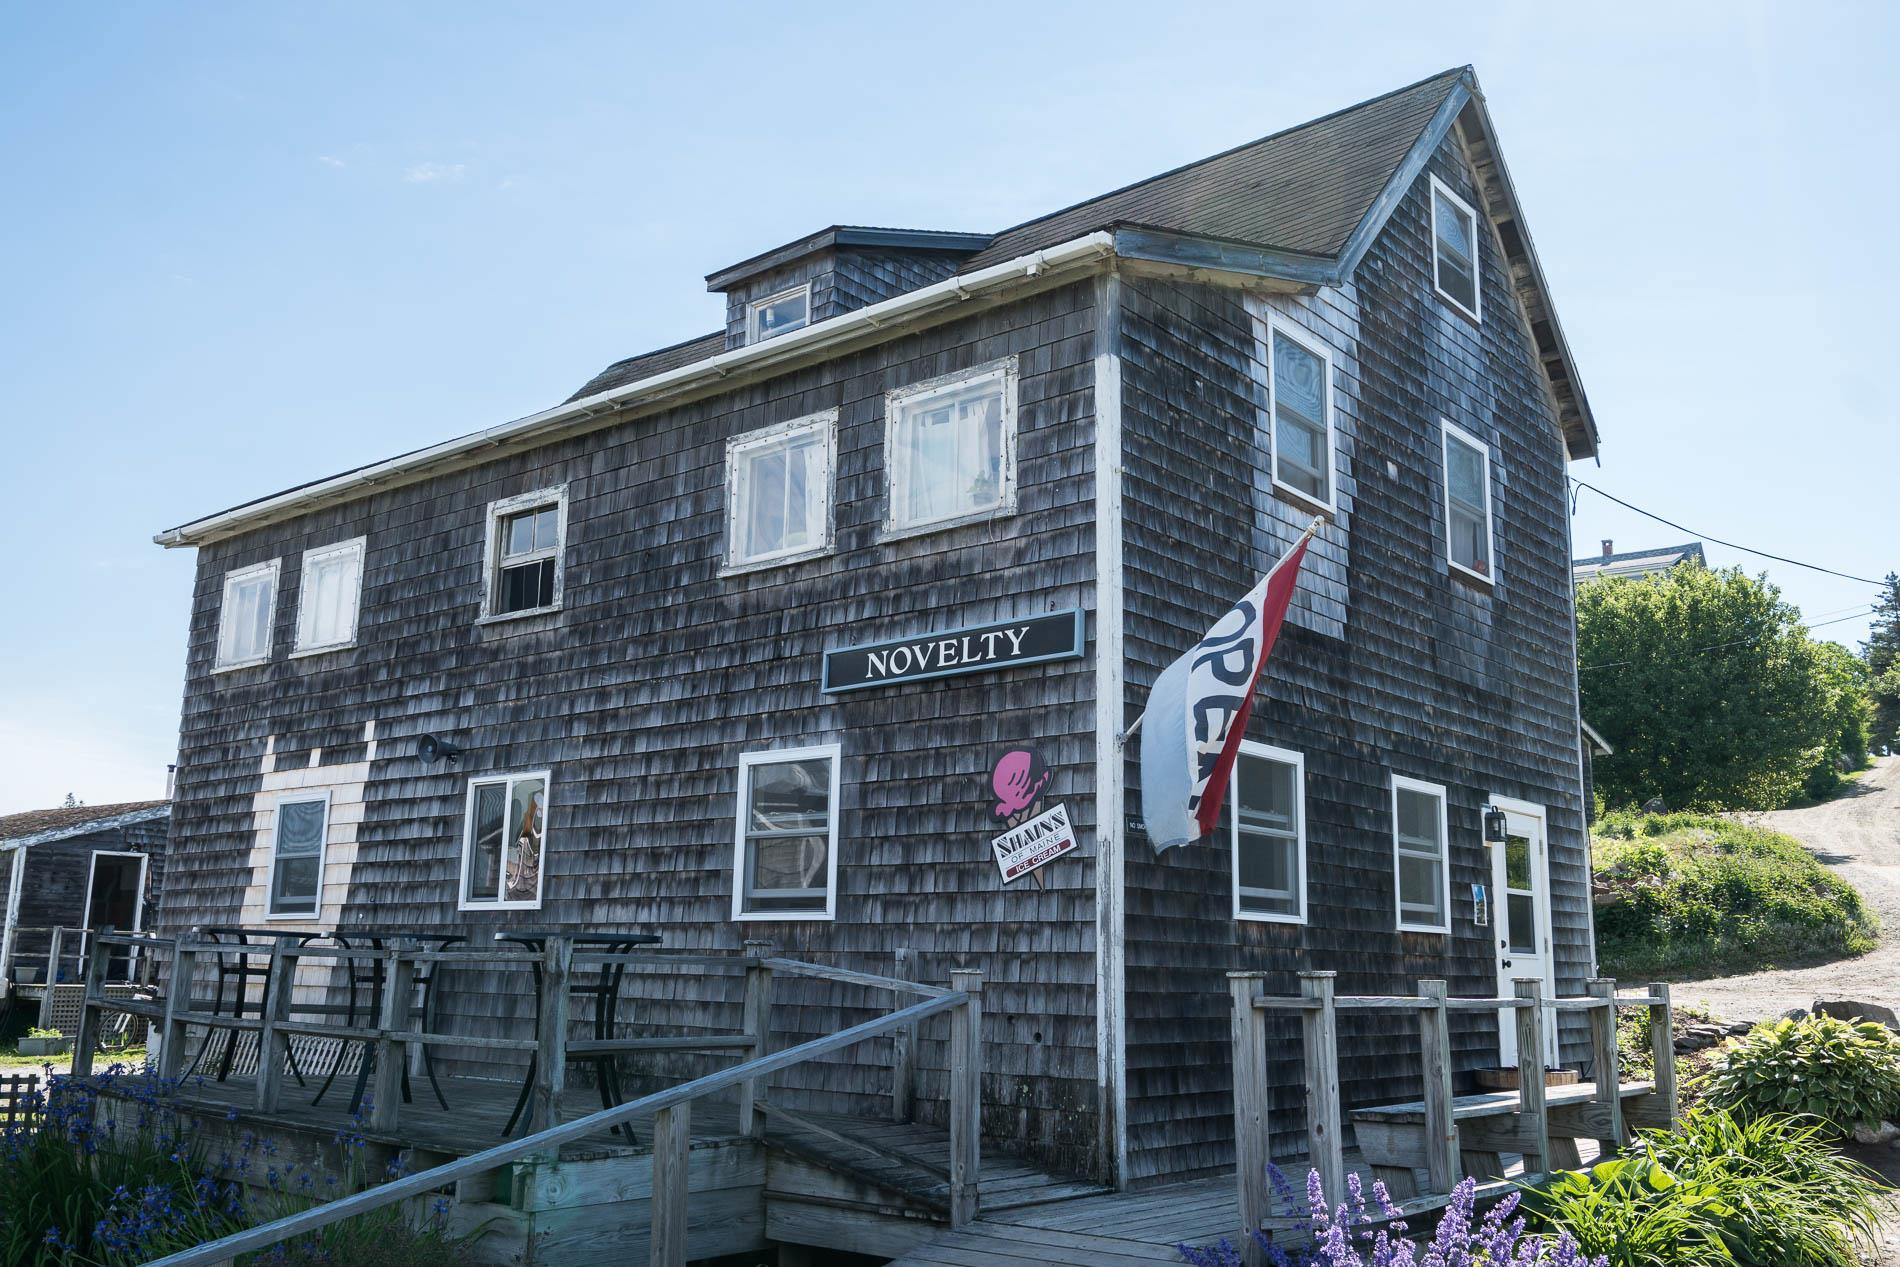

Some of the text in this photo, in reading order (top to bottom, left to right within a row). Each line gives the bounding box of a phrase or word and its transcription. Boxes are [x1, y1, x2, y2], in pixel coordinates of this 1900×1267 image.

[864, 626, 1030, 679] NOVELTY
[1011, 833, 1061, 864] OF MAINE
[1015, 844, 1061, 873] ICE CREAM
